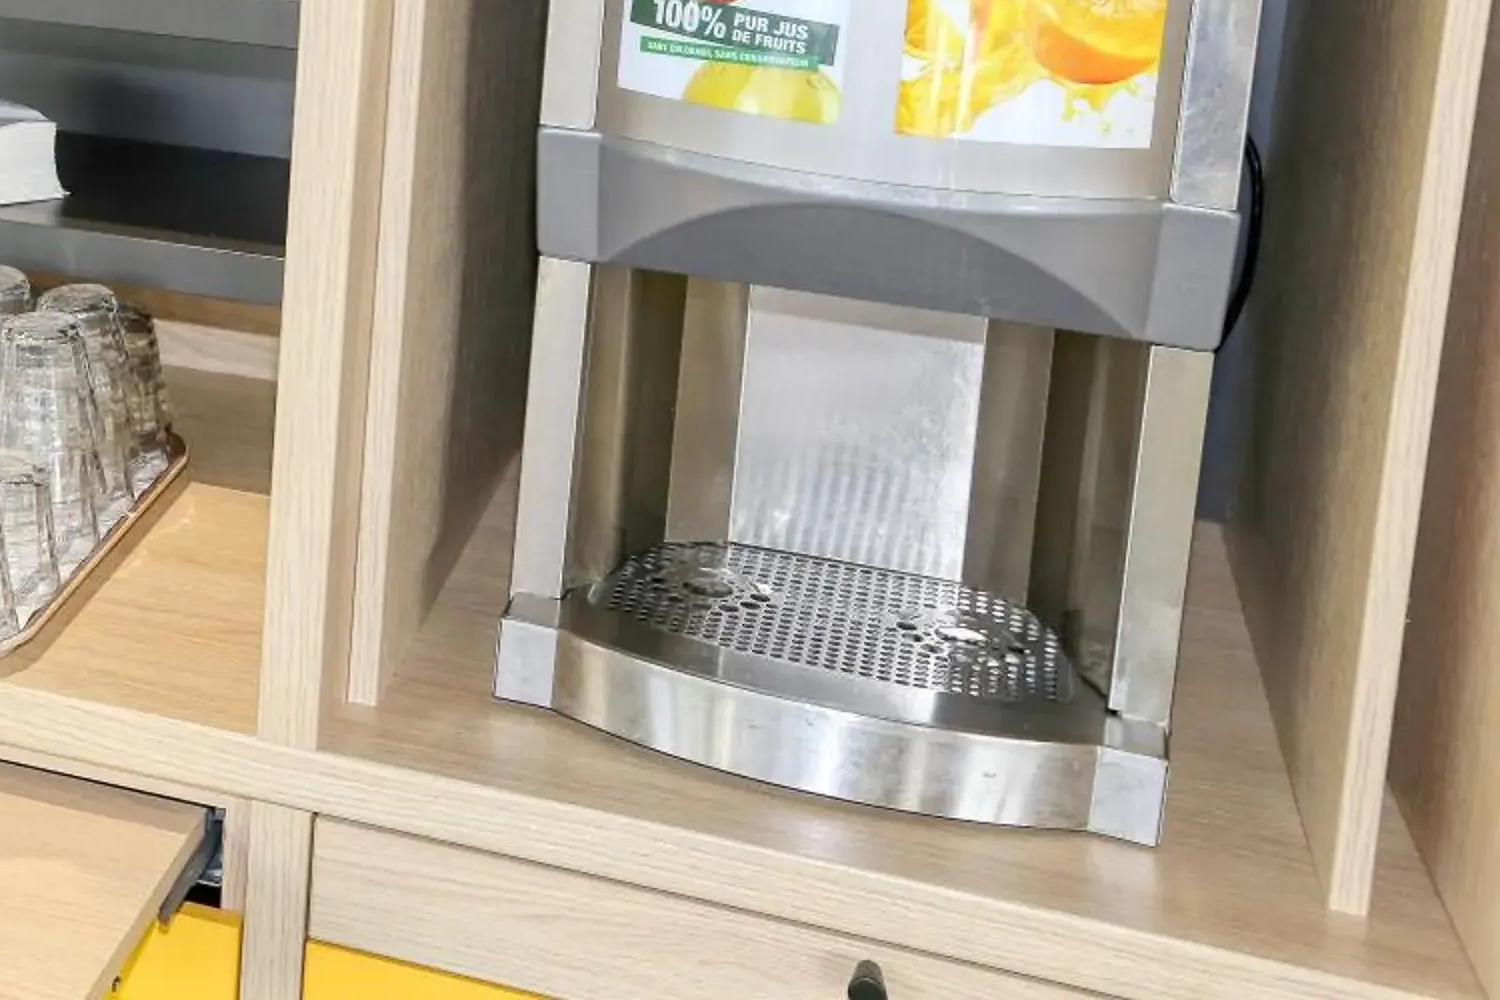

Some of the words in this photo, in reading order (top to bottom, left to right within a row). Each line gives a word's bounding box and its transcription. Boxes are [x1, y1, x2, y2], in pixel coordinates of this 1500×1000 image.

[733, 12, 768, 33] PUR
[774, 23, 809, 41] JUS
[731, 29, 751, 43] DE
[755, 33, 807, 55] FRUITS
